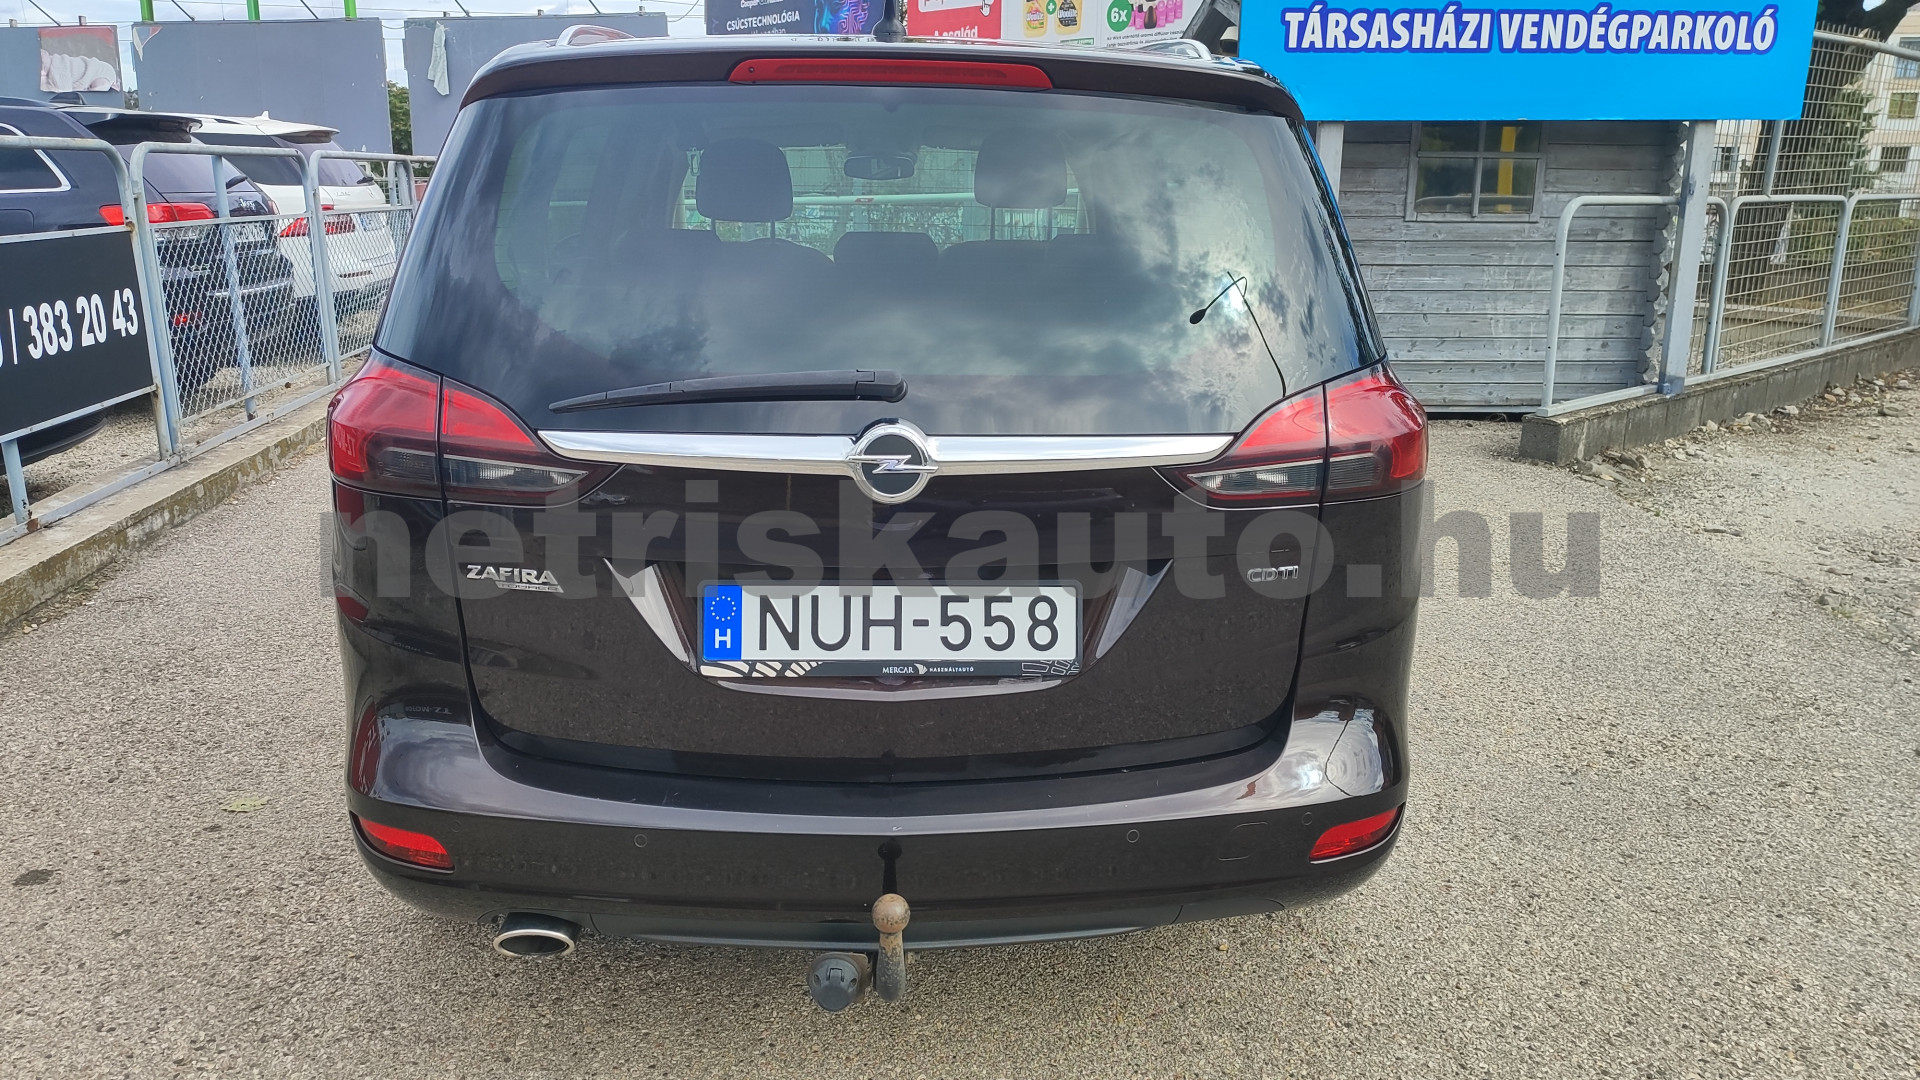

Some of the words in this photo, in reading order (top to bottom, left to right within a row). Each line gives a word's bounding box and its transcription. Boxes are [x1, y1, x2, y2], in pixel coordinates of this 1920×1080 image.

[727, 11, 801, 31] CSÚCSTECHNOLÓGIA
[1110, 7, 1128, 23] 6x
[1285, 5, 1492, 49] TÁRSASHÁZI
[1500, 6, 1776, 51] VENDÉGPARKOLÓ
[23, 300, 73, 360] 383
[76, 294, 107, 347] 20
[112, 288, 139, 338] 43
[466, 564, 559, 585] ZAFIRA
[1247, 565, 1299, 583] CDTI
[768, 595, 1069, 652] NUH-558
[724, 628, 742, 649] H
[882, 666, 914, 674] MERCAR
